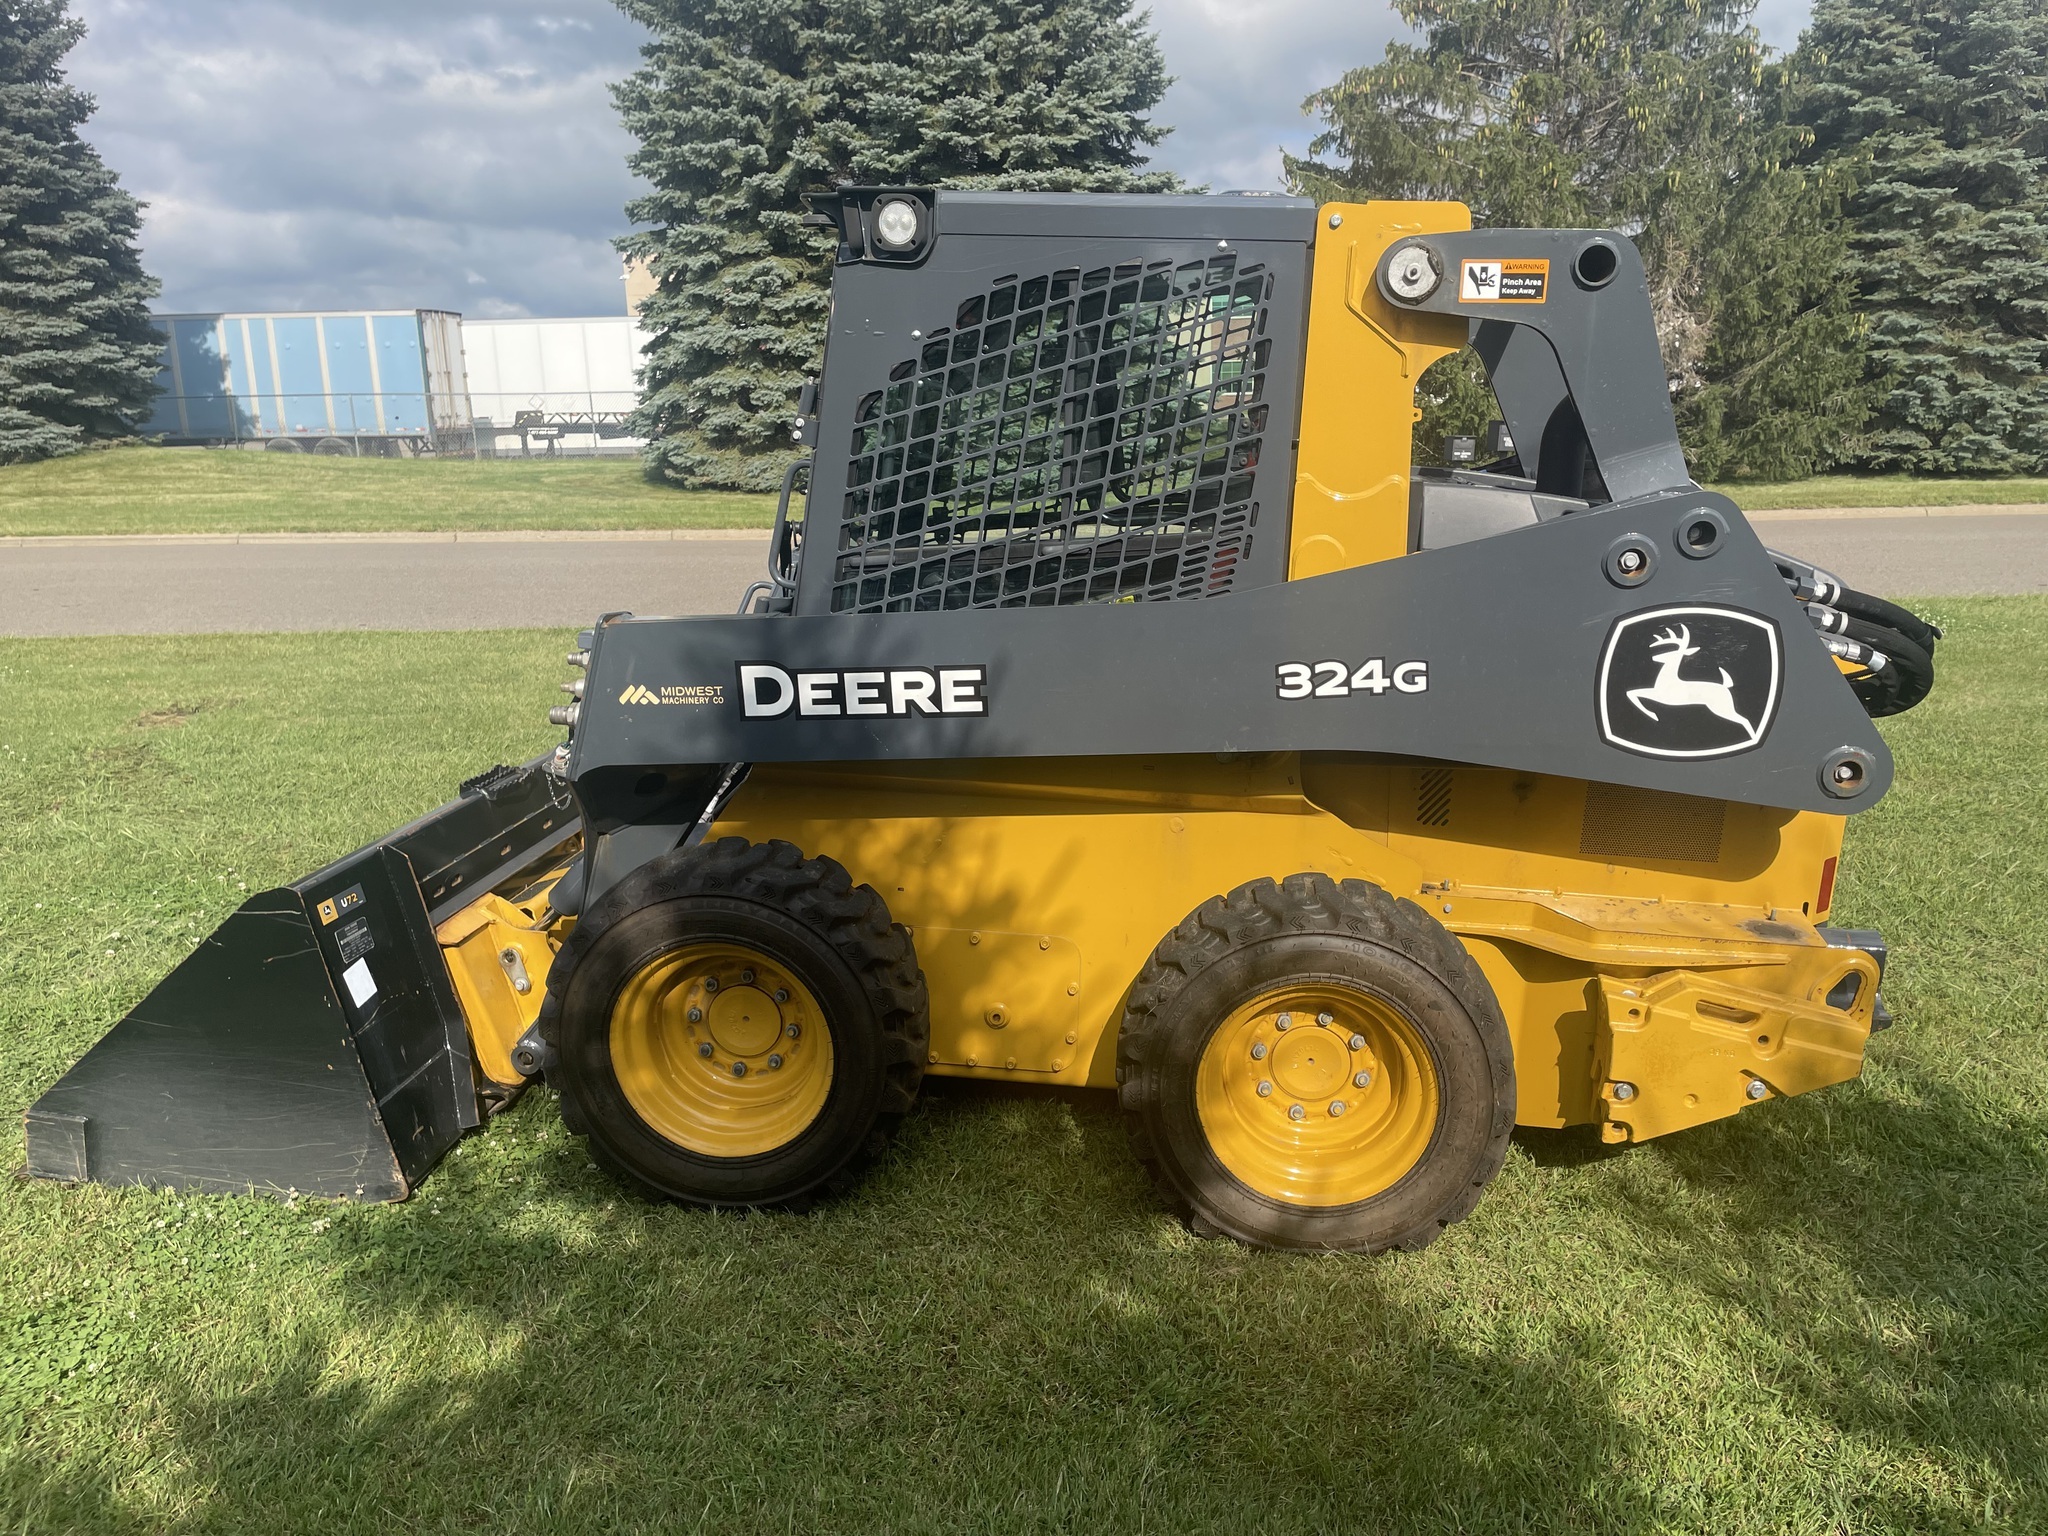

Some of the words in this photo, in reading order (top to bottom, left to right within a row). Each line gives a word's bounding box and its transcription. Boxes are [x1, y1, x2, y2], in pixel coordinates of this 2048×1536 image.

[1502, 278, 1523, 286] Pinch
[1277, 658, 1428, 699] 324G
[660, 686, 723, 696] MIDWEST
[739, 664, 985, 717] DEERE
[661, 696, 709, 705] MACHINERY
[712, 696, 724, 705] CO
[340, 892, 359, 908] U72
